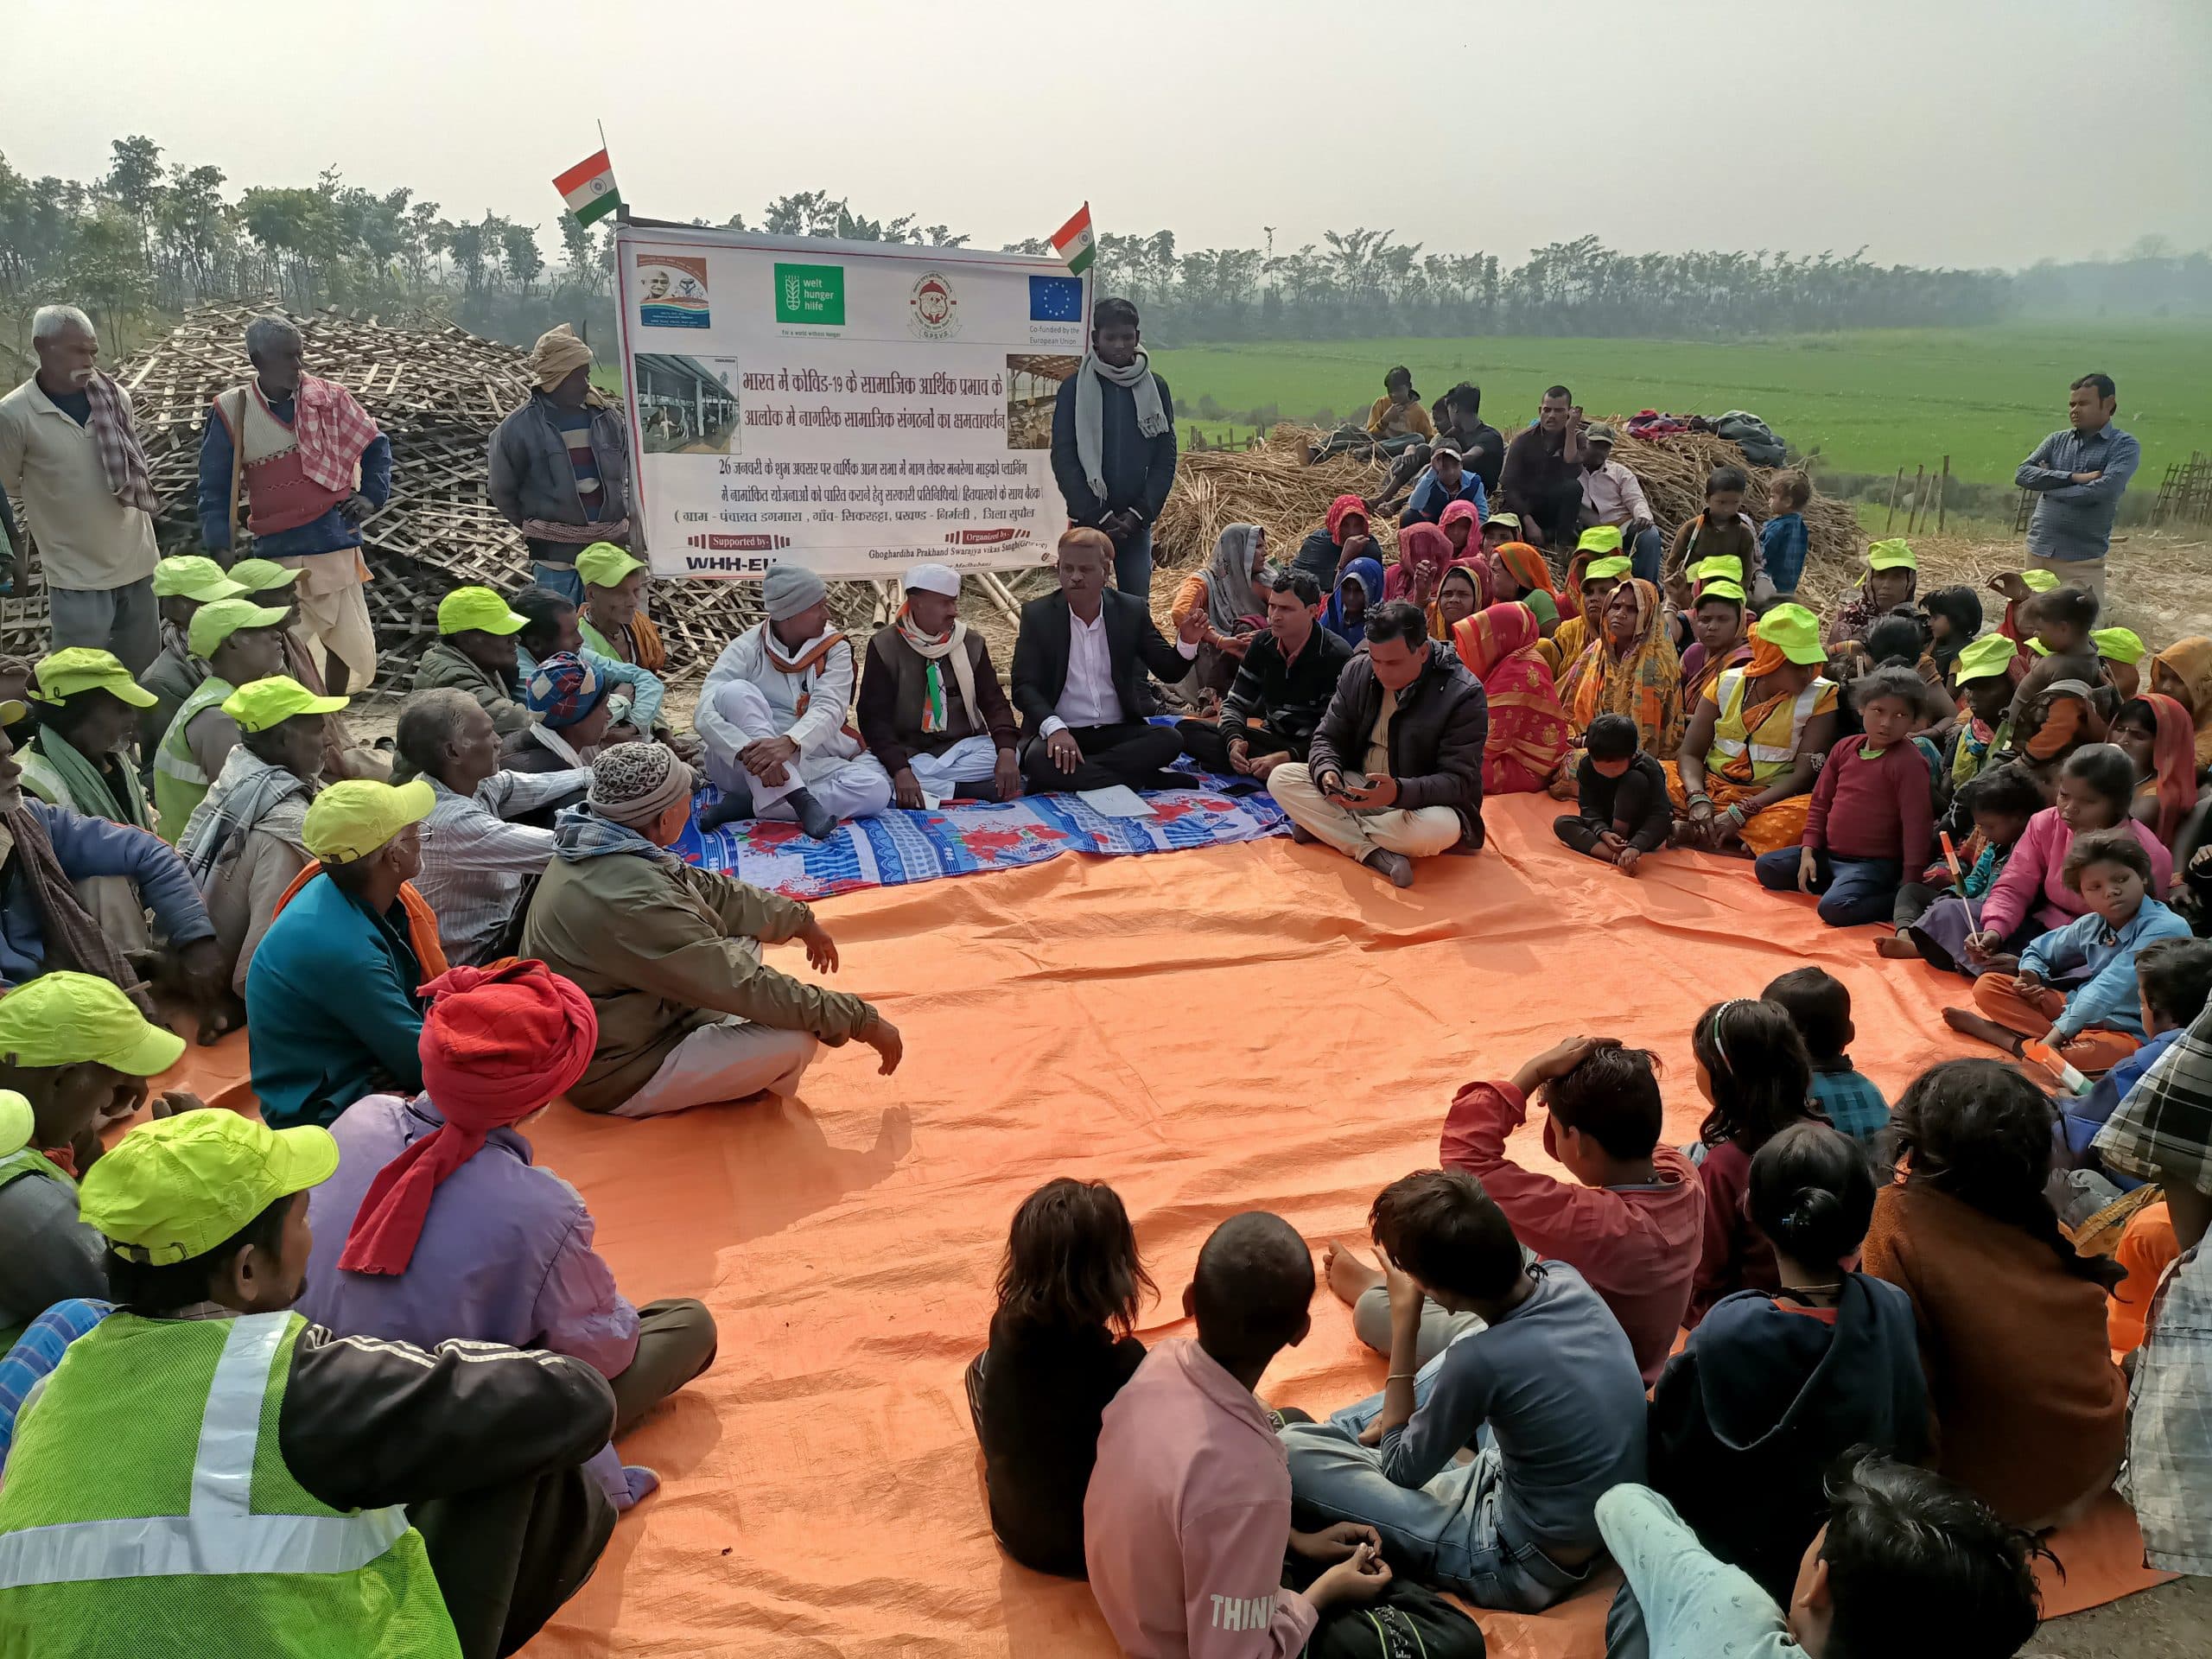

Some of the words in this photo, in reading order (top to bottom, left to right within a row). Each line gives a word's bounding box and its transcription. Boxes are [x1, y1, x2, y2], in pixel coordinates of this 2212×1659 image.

[803, 278, 823, 288] welt
[804, 289, 834, 301] hunger
[804, 301, 823, 311] hilfe
[1030, 325, 1062, 334] Co-funded
[743, 372, 774, 391] भारत
[846, 370, 857, 392] के
[860, 371, 916, 394] सामाजिक
[918, 372, 957, 395] आर्थिक
[959, 378, 988, 396] प्रभाव
[991, 373, 1002, 396] के
[744, 404, 783, 426] आलोक
[799, 406, 842, 427] नागरिक
[843, 406, 895, 428] सामाजिक
[937, 413, 950, 429] का
[953, 409, 1005, 429] क्षमतावर्धन
[719, 456, 731, 474] 26
[733, 458, 762, 474] जनवरी
[764, 458, 773, 475] के
[775, 462, 791, 480] शुभ
[792, 462, 818, 475] अवसर
[820, 462, 831, 475] पर
[833, 458, 859, 475] वार्षिक
[861, 463, 877, 475] आम
[880, 463, 897, 475] सभा
[908, 463, 925, 475] भाग
[926, 459, 945, 475] लेकर
[947, 459, 974, 475] मनरेगा
[1001, 459, 1027, 474] प्लानिंग
[730, 485, 768, 501] नामांकित
[810, 485, 822, 501] को
[824, 485, 847, 501] पारित
[849, 485, 870, 501] कराने
[873, 485, 883, 505] हेतु
[885, 485, 915, 501] सरकारी
[1000, 485, 1007, 500] के
[1008, 488, 1024, 499] साथ
[720, 510, 757, 523] पंचायत
[983, 507, 1007, 519] जिला
[713, 536, 755, 548] Supported
[966, 531, 999, 542] Organized
[868, 548, 914, 560] Ghoghardiha
[916, 547, 949, 557] Prakhand
[950, 546, 982, 556] Swarajya
[983, 545, 1001, 554] vikas
